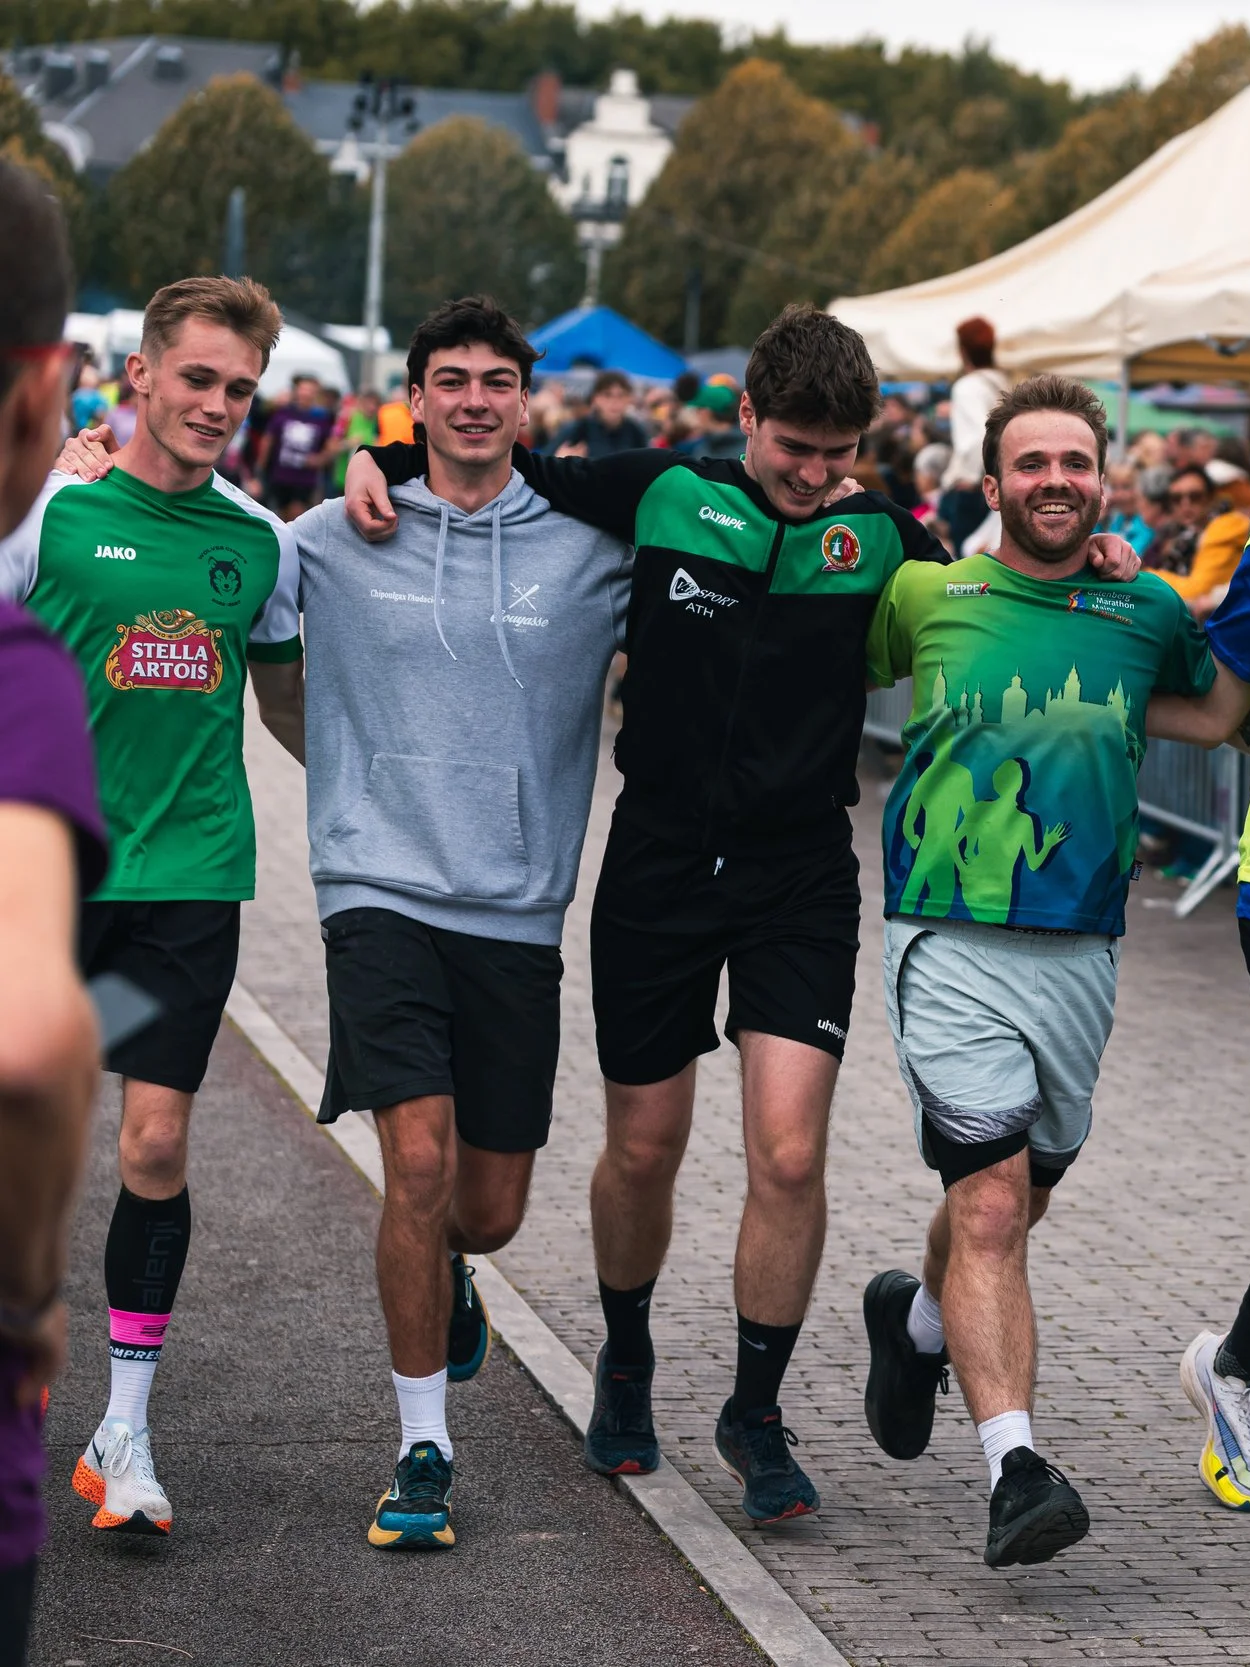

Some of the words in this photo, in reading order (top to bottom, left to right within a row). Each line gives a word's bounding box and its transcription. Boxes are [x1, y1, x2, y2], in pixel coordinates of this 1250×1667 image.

[699, 506, 747, 531] OLYMPIC
[94, 545, 137, 561] JAKO
[946, 582, 991, 597] PEPPEX
[1087, 590, 1131, 602] Gutenberg
[696, 589, 740, 608] SPORT
[1096, 597, 1135, 610] Marathon
[685, 602, 714, 618] ATH
[149, 625, 166, 638] ANNO
[175, 627, 193, 638] 1366
[131, 641, 209, 662] STELLA
[129, 660, 208, 681] ARTOIS
[132, 1219, 183, 1312] alenji
